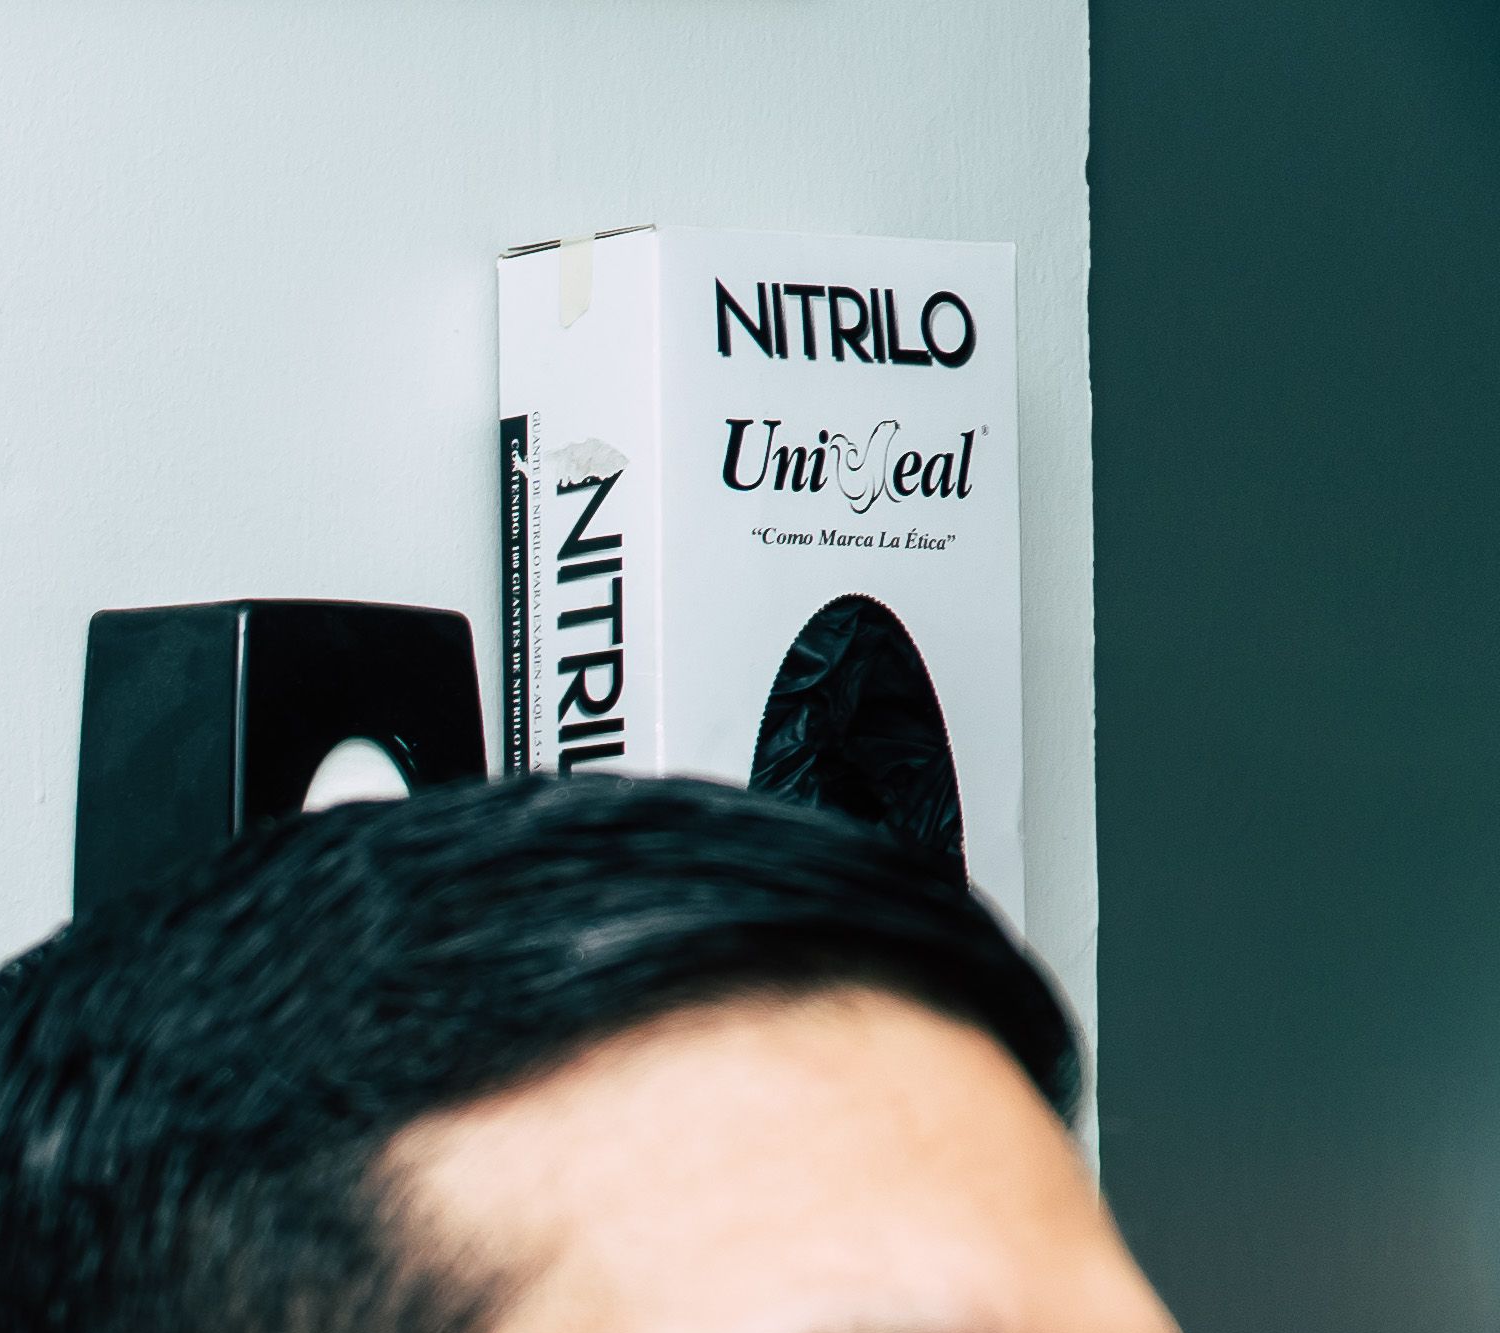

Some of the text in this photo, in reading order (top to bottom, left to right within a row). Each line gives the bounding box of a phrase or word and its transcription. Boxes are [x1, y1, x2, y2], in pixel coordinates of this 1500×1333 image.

[715, 276, 977, 368] NITRILO
[533, 505, 541, 568] NITRILO
[818, 529, 873, 548] Marca
[878, 531, 900, 549] La
[512, 572, 521, 648] GUANTES
[533, 571, 541, 611] PARA
[512, 653, 521, 674] DE
[512, 679, 521, 747] NITRILO
